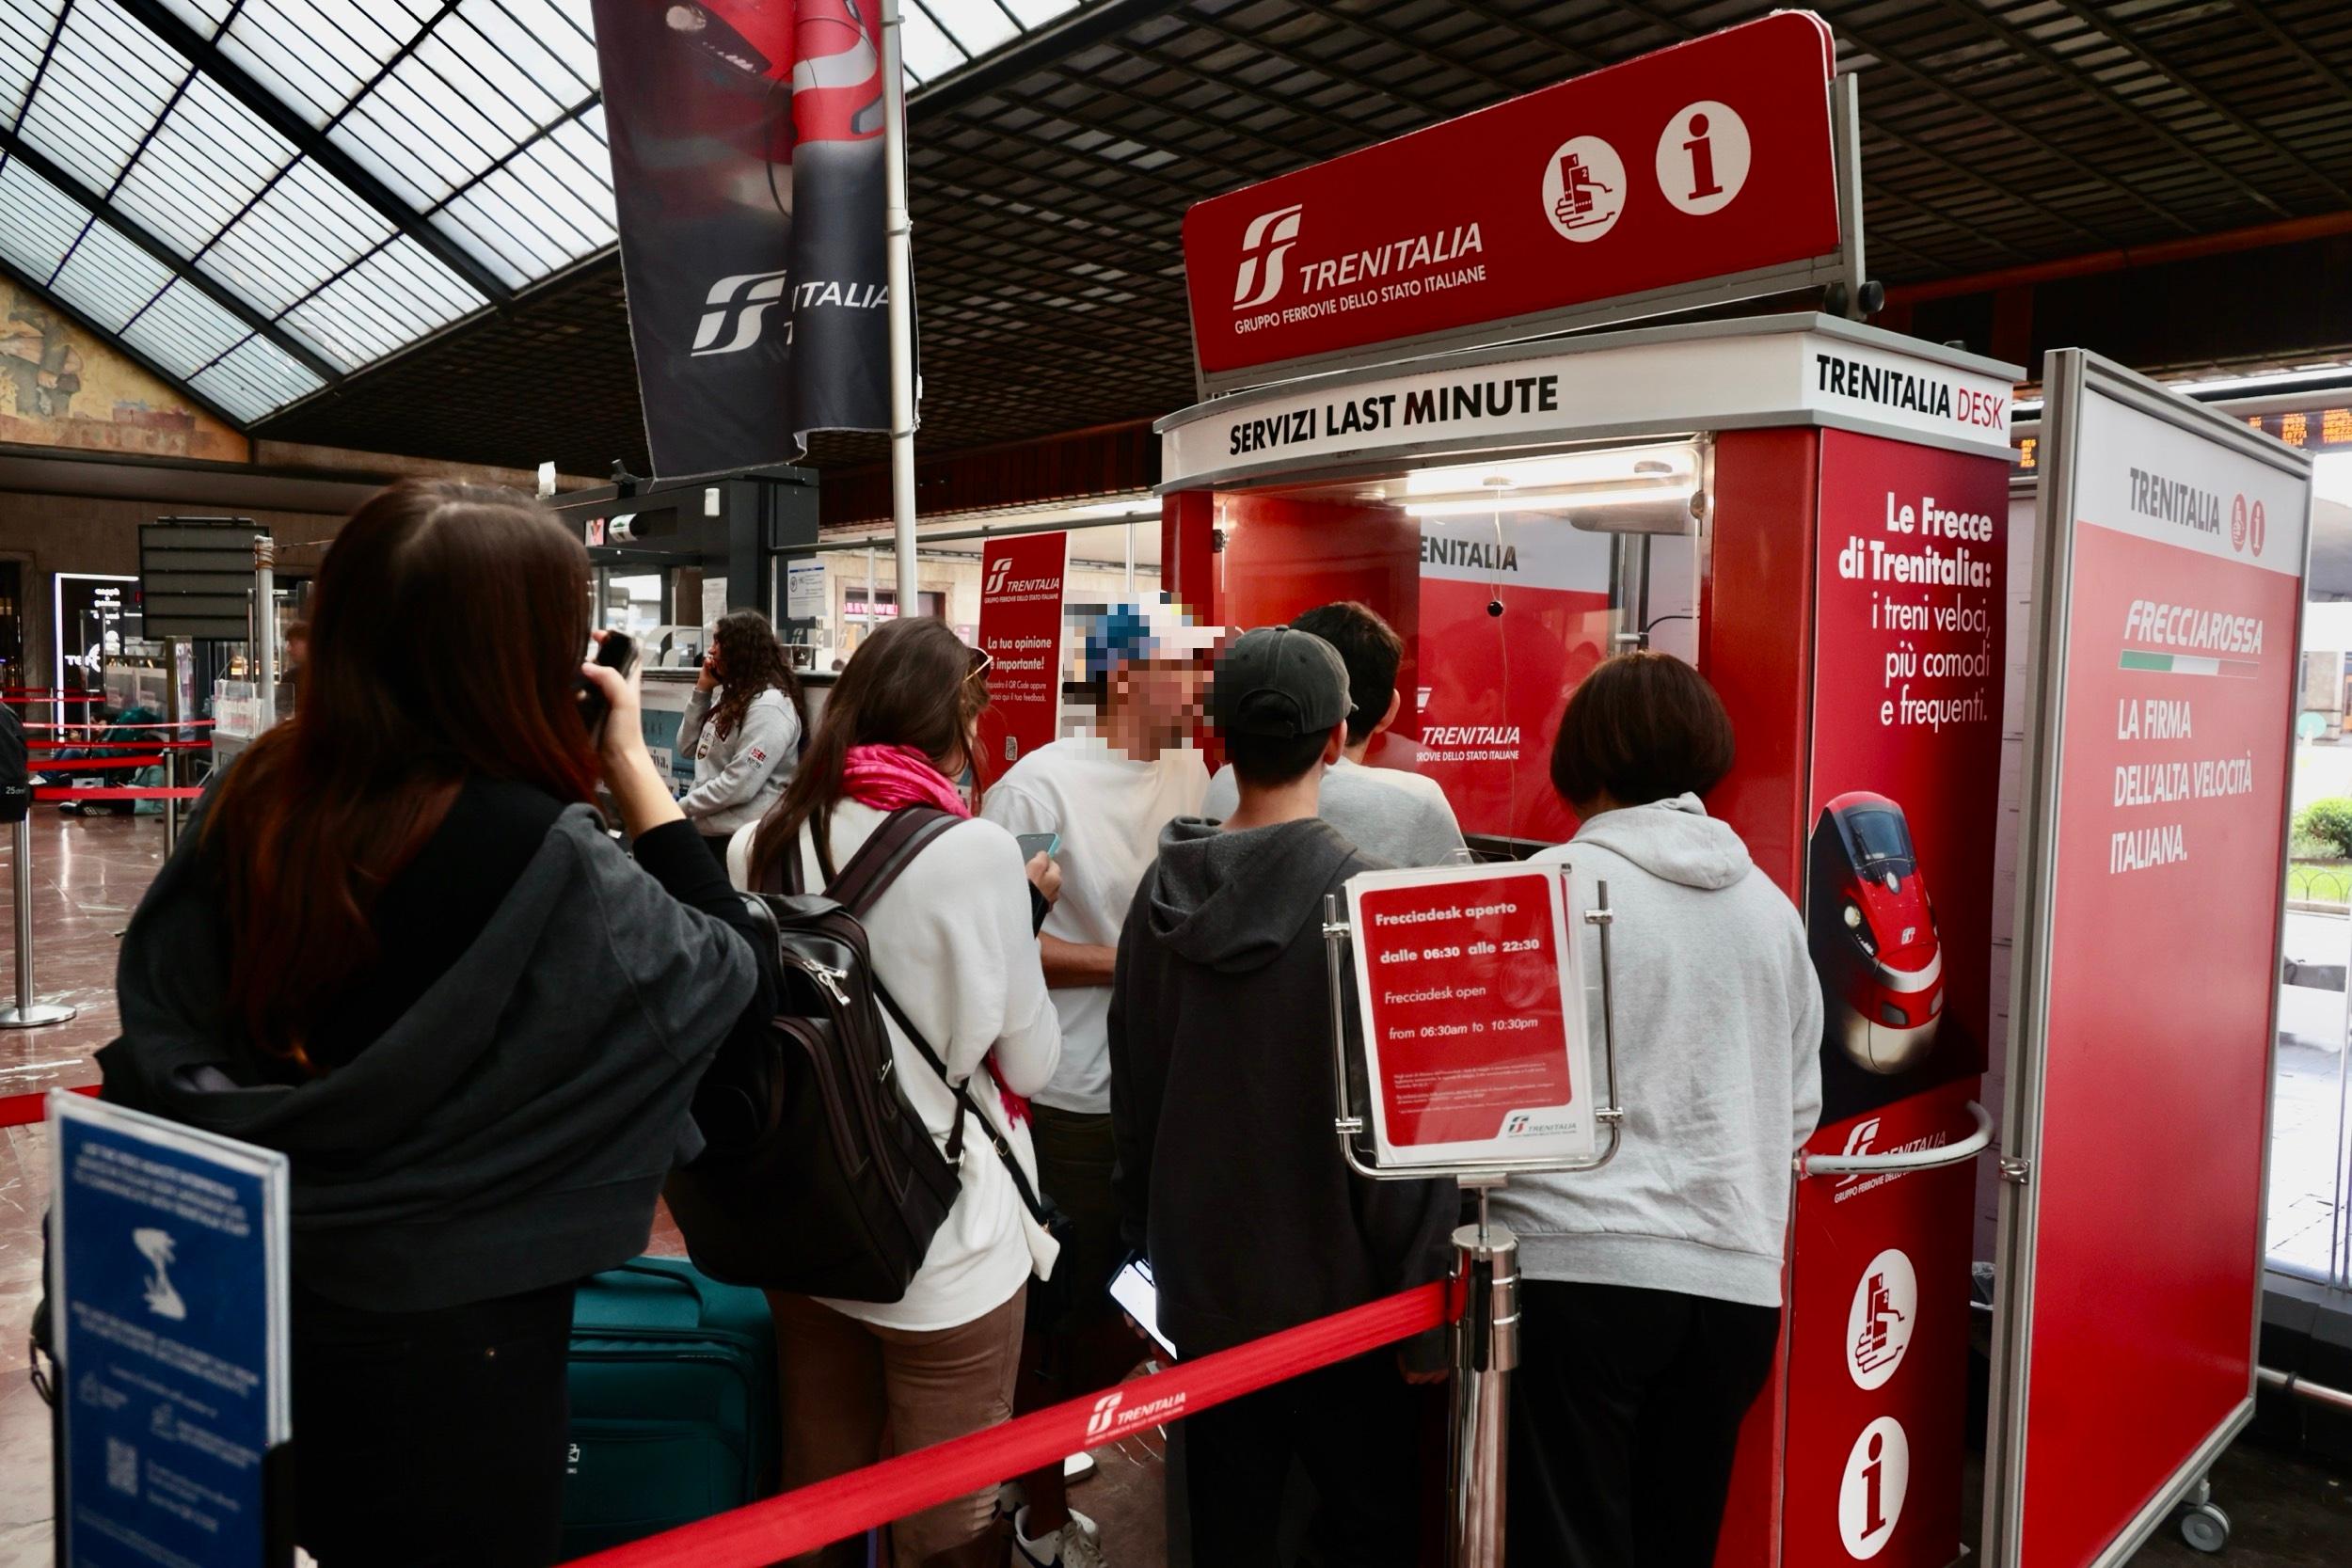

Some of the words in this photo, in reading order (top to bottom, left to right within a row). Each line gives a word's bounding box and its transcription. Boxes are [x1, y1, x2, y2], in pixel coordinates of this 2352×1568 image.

[1299, 222, 1484, 294] TRENITALIA
[1234, 312, 1280, 335] GRUPPO
[1282, 298, 1337, 325] FERROVIE
[1339, 290, 1378, 311] DELLO
[1381, 279, 1422, 303] STATO
[1424, 264, 1486, 293] ITALIANE
[1817, 354, 1952, 419] TRENITALIA
[1957, 387, 2005, 431] DESK
[1230, 407, 1316, 456] SERVIZI
[1326, 395, 1396, 436] LAST
[1403, 375, 1558, 426] MINUTE
[1886, 491, 1915, 534] Le
[1921, 497, 1994, 543] Frecce
[2130, 467, 2220, 535] TRENITALIA
[1420, 535, 1518, 572] ENITALIA
[1838, 535, 1865, 579] di
[1869, 540, 1992, 589] Trenitalia:
[1007, 578, 1060, 593] TRENITALIA
[1872, 591, 1878, 629] i
[1884, 594, 1929, 631] treni
[1934, 593, 1991, 639] veloci,
[2123, 599, 2264, 655] FRECCIAROSSA
[988, 636, 997, 649] La
[1000, 638, 1012, 649] tua
[1015, 636, 1052, 652] opinione
[1885, 640, 1916, 689] più
[1922, 639, 1991, 677] comodi
[996, 657, 1044, 673] importante!
[1881, 700, 1894, 726] e
[1900, 684, 1988, 734] frequenti.
[2118, 699, 2139, 740] LA
[2144, 699, 2192, 739] FIRMA
[1422, 726, 1520, 745] TRENITALIA
[1416, 752, 1440, 762] ROVIE
[1442, 751, 1465, 761] DELLO
[1466, 751, 1487, 761] STATO
[1489, 751, 1518, 760] ITALIANE
[2114, 762, 2189, 807] DELL'ALTA
[2193, 749, 2252, 799] VELOCITÀ
[2110, 824, 2187, 875] ITALIANA.
[1375, 906, 1461, 927] Frecciadesk
[1465, 903, 1517, 919] aperto
[1380, 949, 1418, 964] dalle
[1423, 946, 1460, 960] 06:30
[1468, 942, 1496, 956] alle
[1502, 939, 1540, 953] 22:30
[1385, 986, 1453, 1005] Frecciadesk
[1456, 986, 1486, 1000] open
[1389, 1027, 1415, 1040] from
[1421, 1024, 1468, 1037] 06:30am
[1472, 1022, 1484, 1033] to
[1491, 1018, 1538, 1032] 10:30pm
[1528, 1121, 1578, 1132] TRENITALIA
[1835, 1186, 1858, 1204] GRUPPO
[1858, 1175, 1884, 1196] FERROVIE
[1118, 1392, 1186, 1425] TRENITALIA
